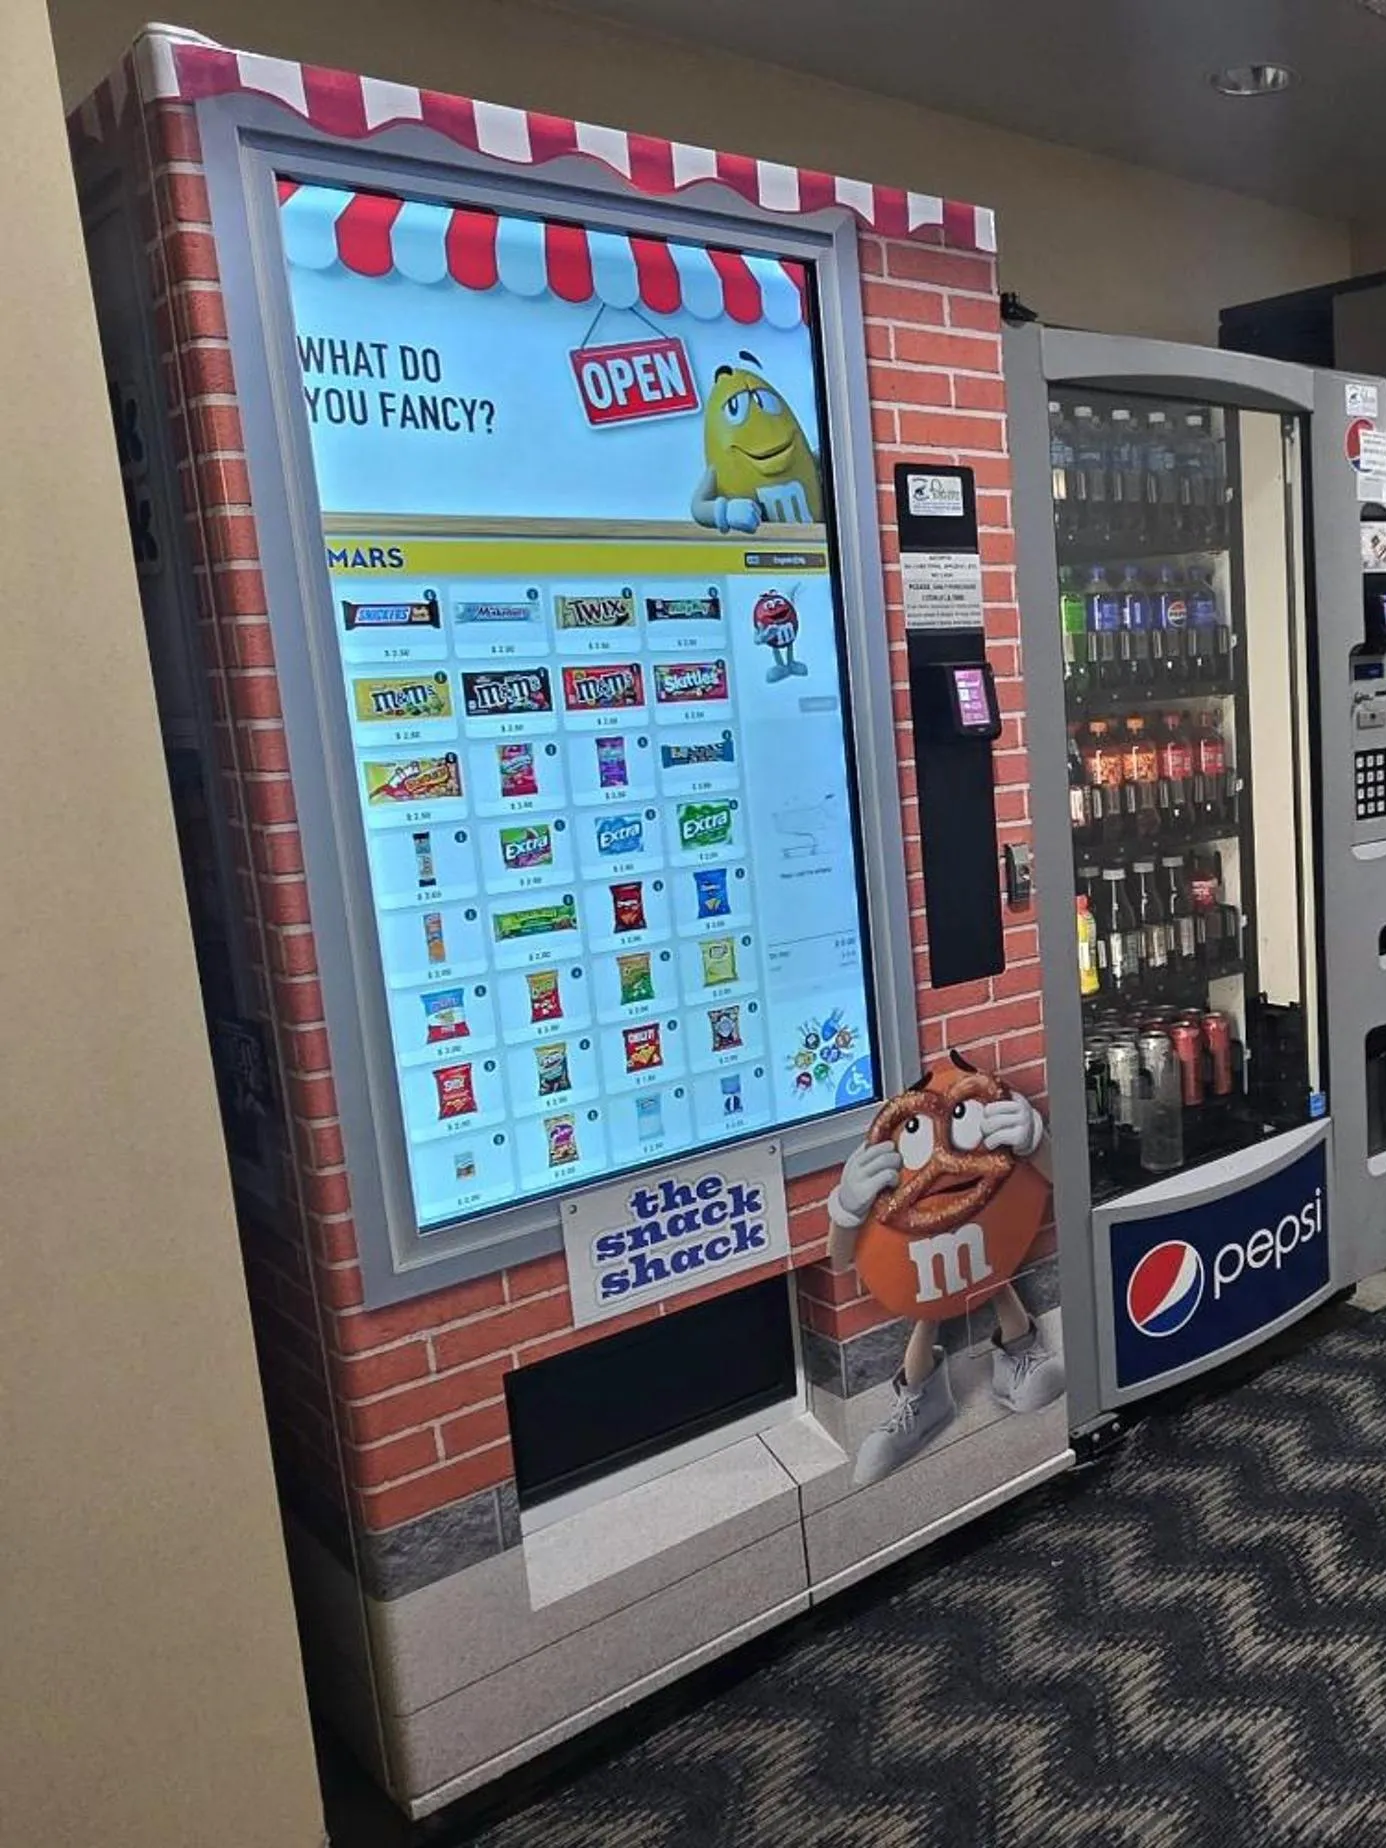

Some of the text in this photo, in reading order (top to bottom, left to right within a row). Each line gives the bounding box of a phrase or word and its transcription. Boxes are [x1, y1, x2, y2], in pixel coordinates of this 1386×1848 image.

[297, 336, 441, 383] WHAT DO
[582, 350, 687, 410] OPEN
[303, 386, 494, 434] YOU FANCY?
[327, 548, 404, 568] MARS
[684, 811, 728, 839] Extra
[631, 1176, 722, 1219] the
[596, 1185, 762, 1261] snack
[1213, 1187, 1322, 1300] pepsi
[601, 1220, 766, 1299] shack
